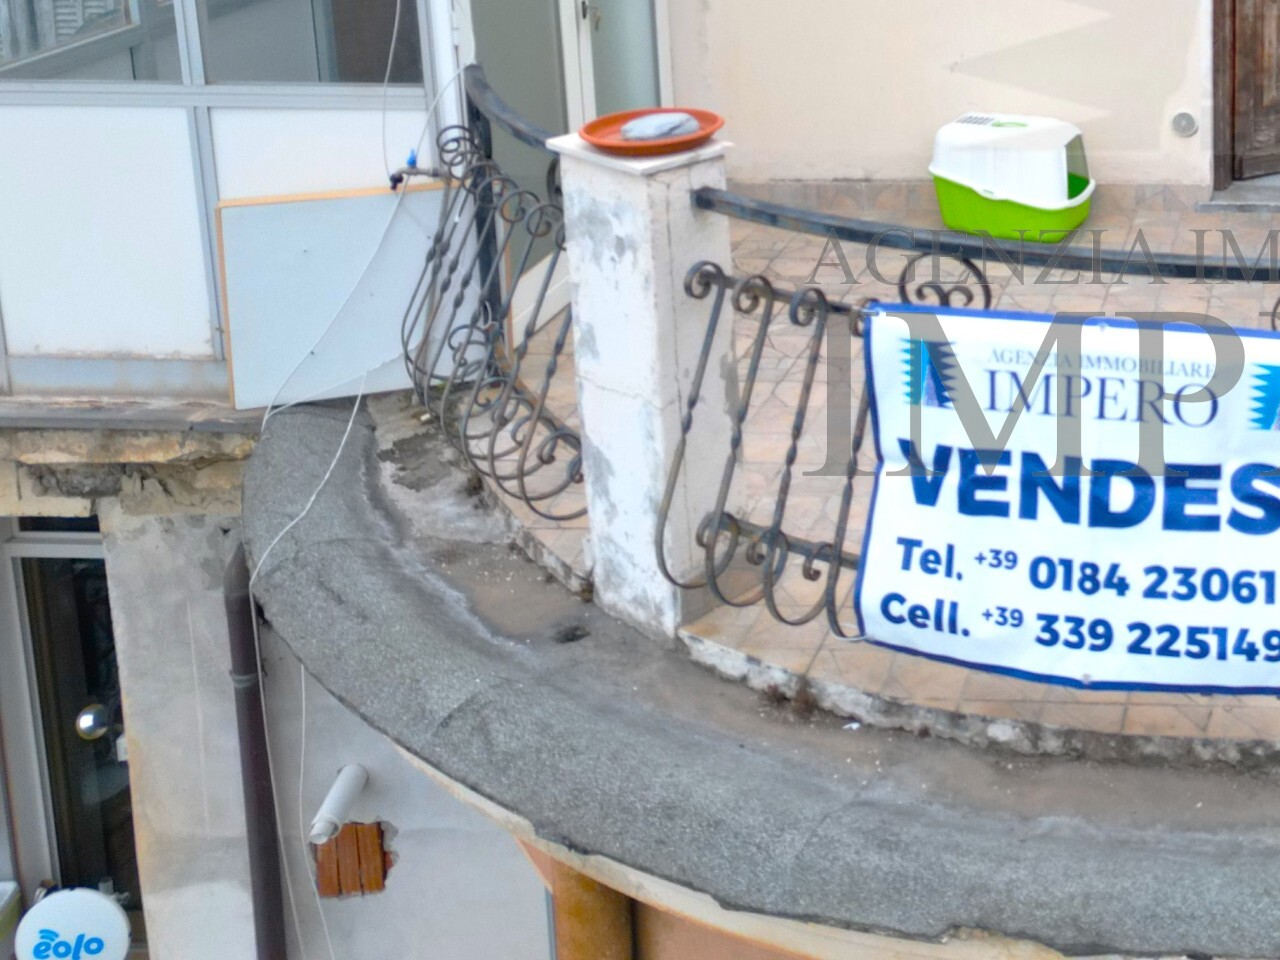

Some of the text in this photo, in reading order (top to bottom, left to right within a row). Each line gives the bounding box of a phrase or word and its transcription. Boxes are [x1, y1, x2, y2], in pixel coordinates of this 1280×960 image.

[987, 348, 1216, 378] AGENZIA IMMOBILIARE
[983, 369, 1219, 428] IMPERO
[897, 537, 963, 581] Tel.
[974, 549, 1018, 571] +39
[1029, 555, 1130, 597] 0184
[879, 592, 970, 637] Cell.
[981, 606, 1024, 628] +39
[1035, 613, 1113, 652] 339
